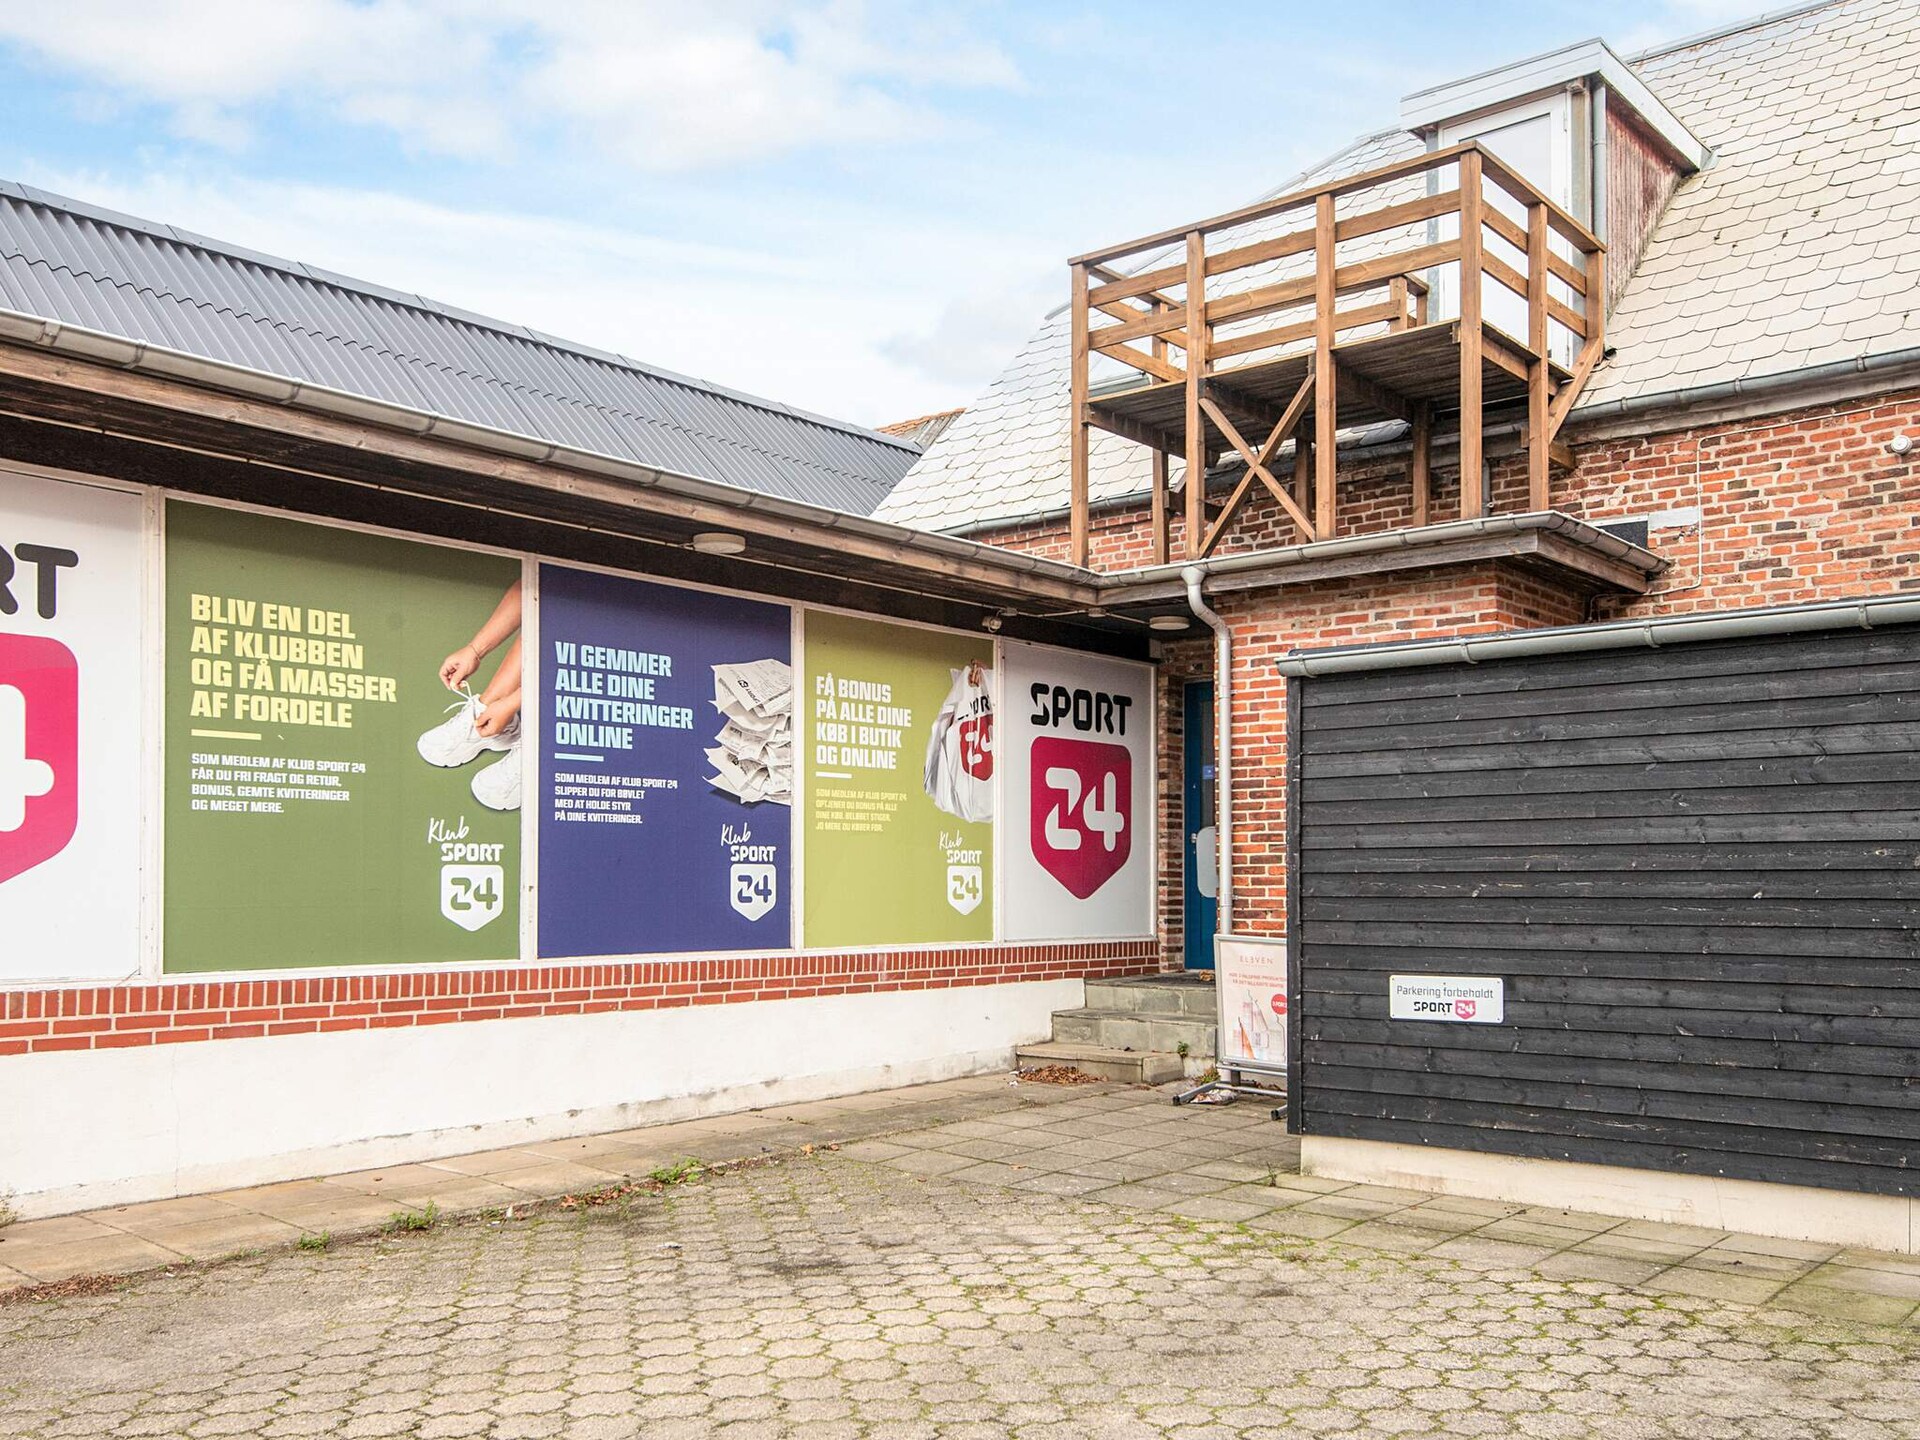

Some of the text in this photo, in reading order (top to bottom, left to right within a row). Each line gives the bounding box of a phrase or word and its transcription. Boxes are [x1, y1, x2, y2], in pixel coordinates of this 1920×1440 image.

[191, 594, 355, 639] BLIV EN DEL
[191, 626, 363, 670] AF KLUBBEN
[555, 641, 672, 677] VI GEMMER
[191, 658, 397, 702] OG FÅ MASSER
[555, 668, 655, 700] ALLE DINE
[816, 672, 891, 703] FÅ BONUS
[191, 690, 352, 728] AF FORDELE
[555, 695, 693, 729] KVITTERINGER
[816, 696, 911, 727] PÅ ALLE DINE
[1031, 682, 1132, 735] SPORT
[555, 722, 633, 749] ONLINE
[816, 722, 902, 748] KØB I BUTIK
[191, 753, 366, 773] SOM MEDLEM AF KLUB SPORT 24
[816, 745, 896, 769] OG ONLINE
[191, 767, 214, 780] FÅR
[216, 770, 232, 781] DU
[234, 771, 251, 782] FRI
[253, 772, 288, 784] FRAGT
[289, 774, 304, 785] OG
[555, 773, 678, 789] SOM MEDLEM AF KLUB SPORT 24
[237, 786, 275, 798] GEMTE
[276, 788, 350, 801] KVITTERINGER
[555, 786, 587, 796] SLIPPER
[589, 787, 600, 797] DU
[601, 788, 616, 797] FOR
[191, 799, 284, 813] OG MEGET MERE.
[555, 799, 631, 811] MED AT HOLDE STYR
[555, 810, 566, 821] PÅ
[567, 812, 586, 821] DINE
[1045, 767, 1124, 852] 24
[428, 816, 469, 844] Klub
[721, 822, 751, 846] Klub
[940, 829, 962, 850] Klub
[441, 843, 504, 861] SPORT
[730, 845, 776, 862] SPORT
[947, 850, 982, 864] SPORT
[451, 877, 498, 910] 24
[738, 875, 772, 903] 24
[952, 875, 979, 900] 24
[1397, 986, 1493, 998] Parkering forbeholdt
[1414, 1002, 1474, 1014] SPORT 24
